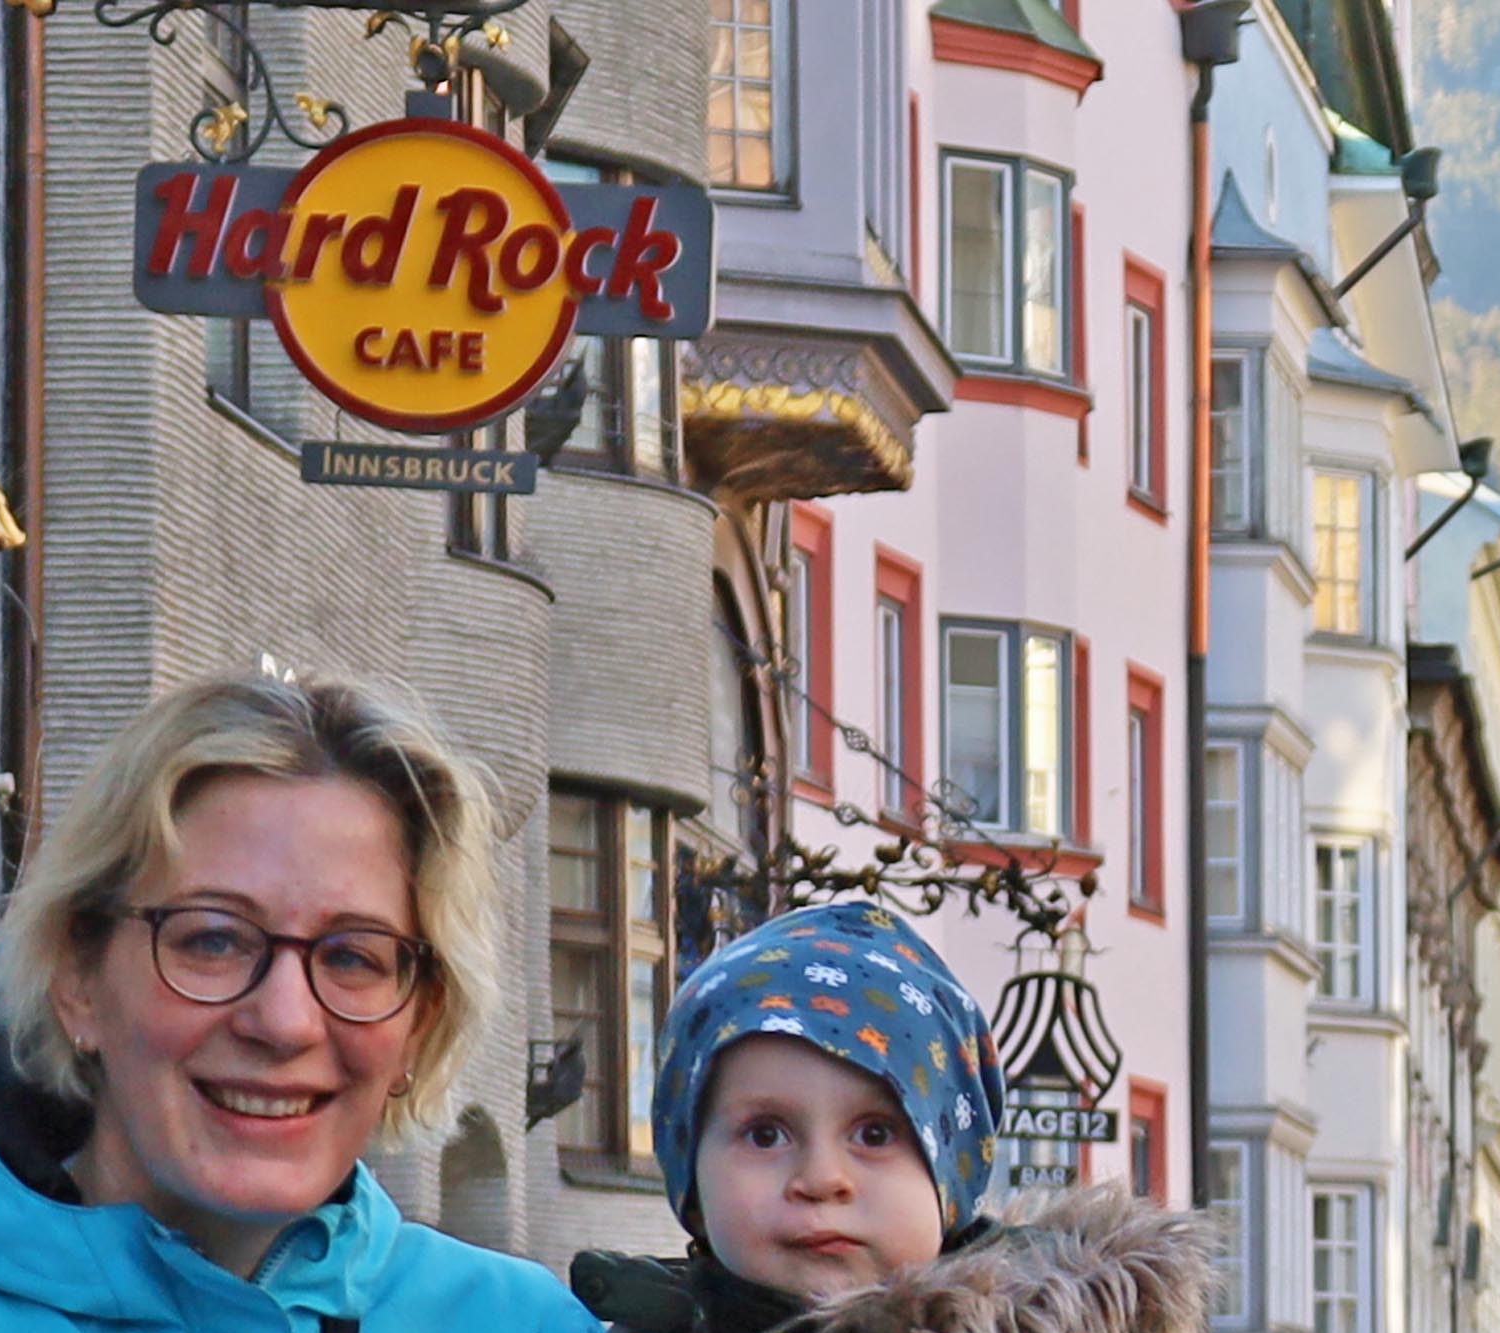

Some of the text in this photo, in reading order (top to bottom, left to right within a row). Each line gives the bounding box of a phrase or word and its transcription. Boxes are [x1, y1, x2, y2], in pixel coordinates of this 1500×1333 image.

[146, 173, 681, 320] Hard Rock
[354, 327, 484, 373] CAFE
[322, 445, 515, 485] INNSBRUCK
[1002, 1107, 1109, 1138] TAGE12
[1021, 1166, 1066, 1185] BAR
